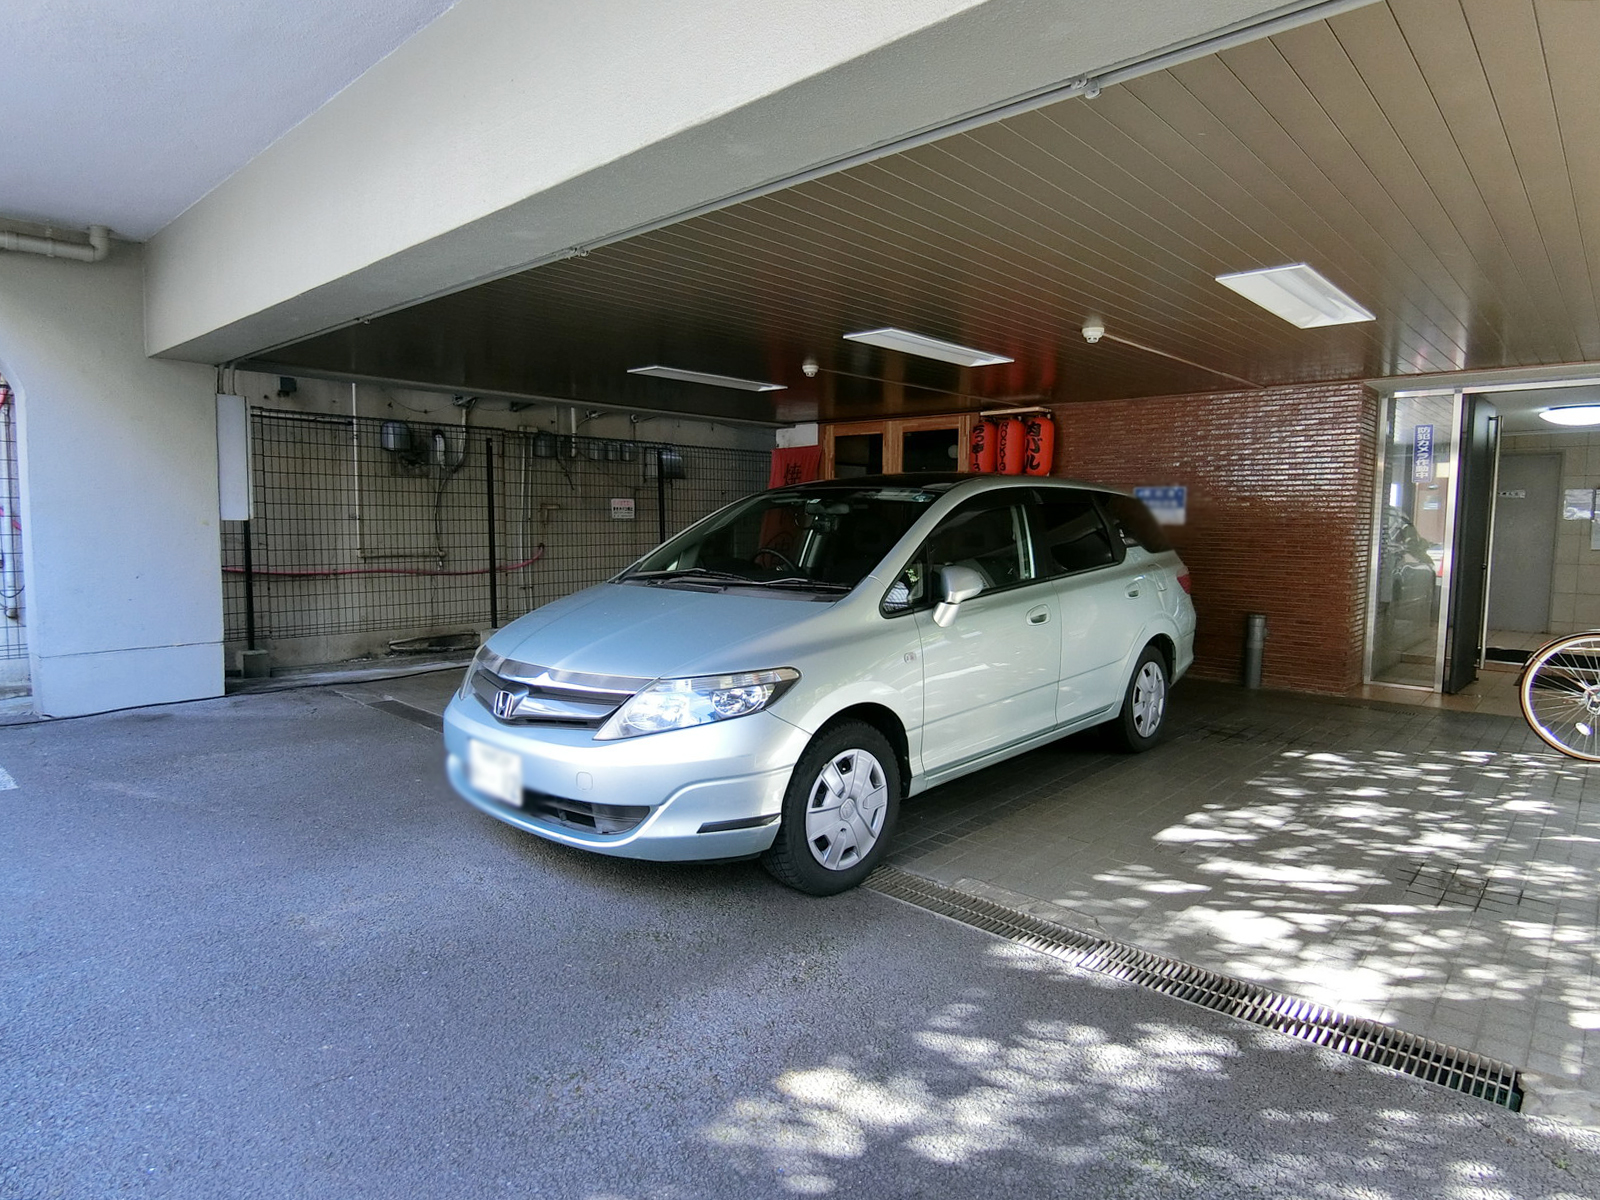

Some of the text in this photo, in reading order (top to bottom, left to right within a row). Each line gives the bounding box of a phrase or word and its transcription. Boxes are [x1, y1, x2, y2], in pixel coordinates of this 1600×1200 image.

[1415, 426, 1431, 479] 防犯カメラ作動中
